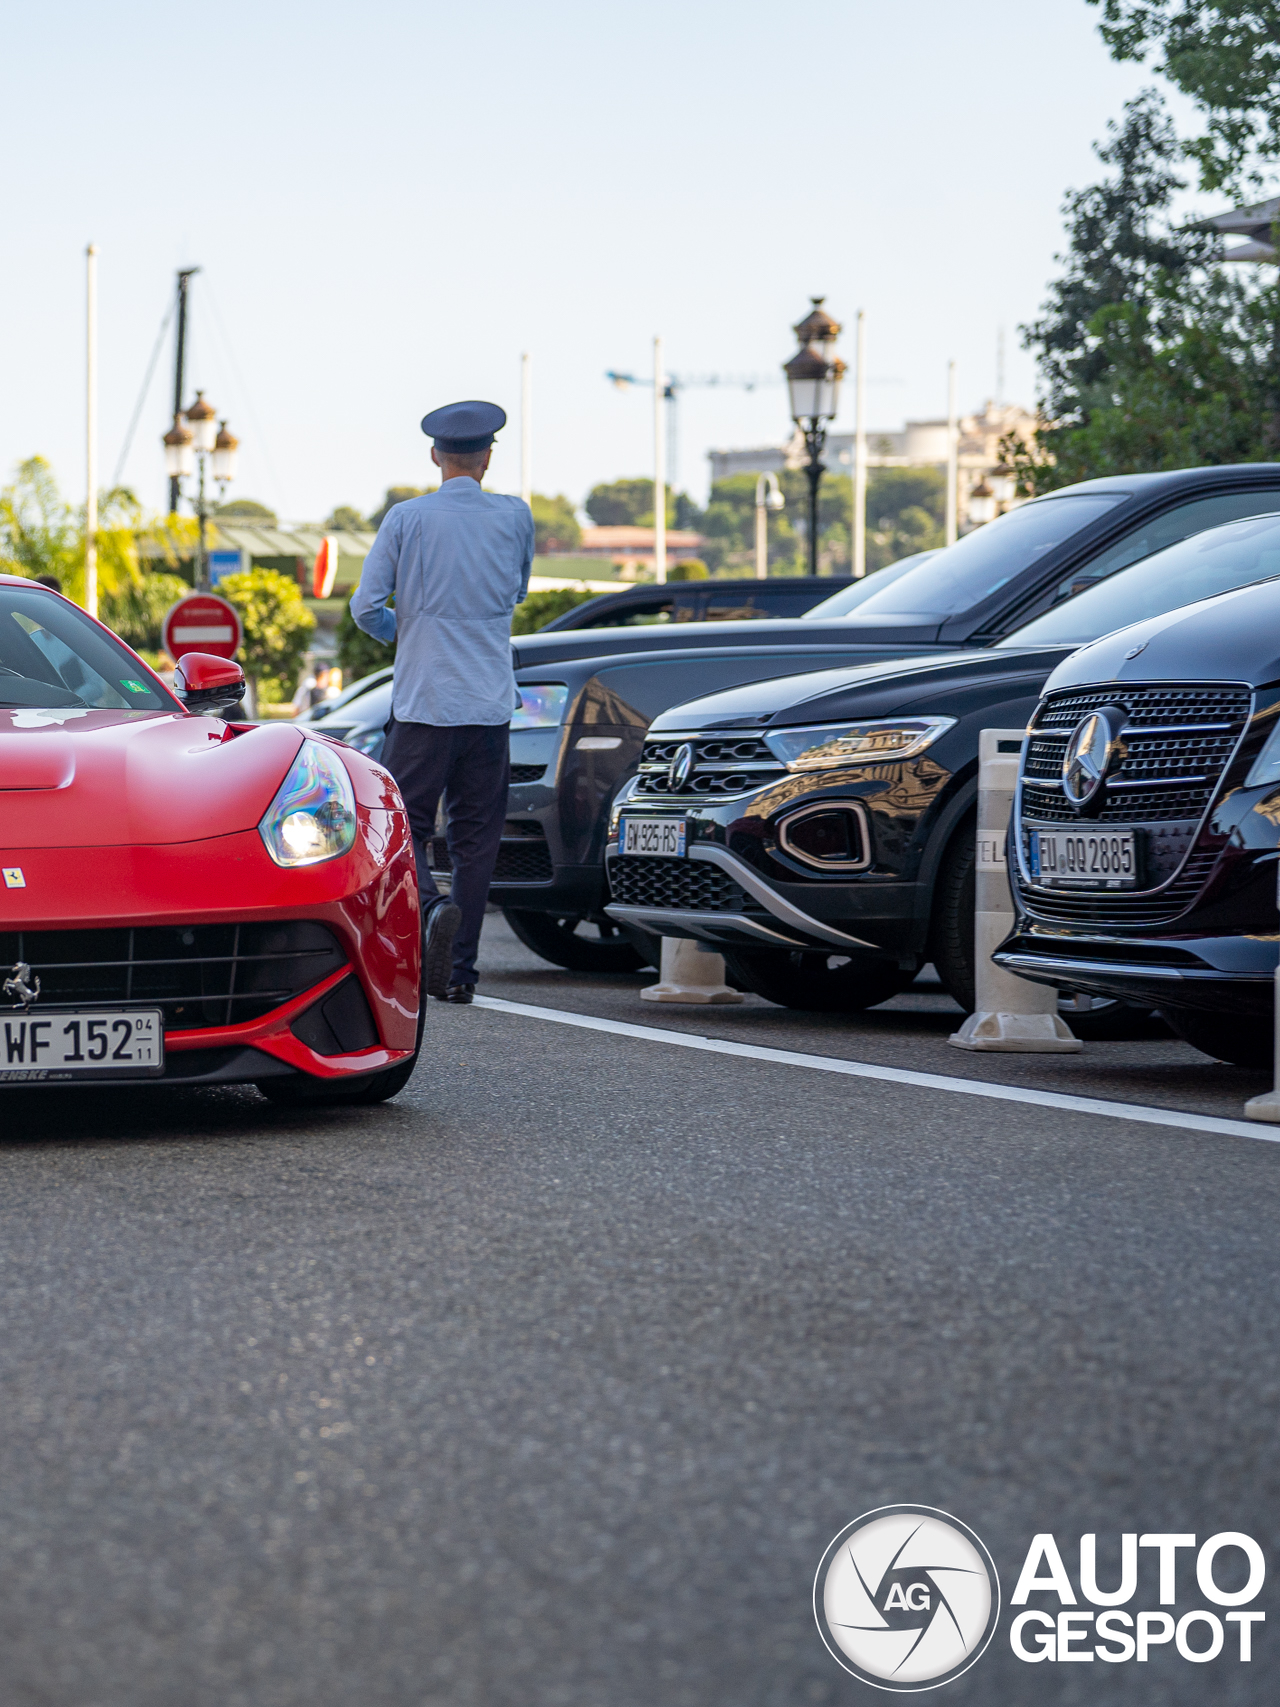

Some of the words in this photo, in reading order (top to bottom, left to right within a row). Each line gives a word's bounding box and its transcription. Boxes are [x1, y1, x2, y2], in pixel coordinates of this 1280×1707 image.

[1040, 836, 1057, 872] EU
[1066, 836, 1086, 873] QQ
[1088, 837, 1132, 874] 2885
[136, 1019, 153, 1031] 04
[5, 1021, 52, 1063] WF
[63, 1019, 133, 1062] 152
[137, 1048, 152, 1060] 11
